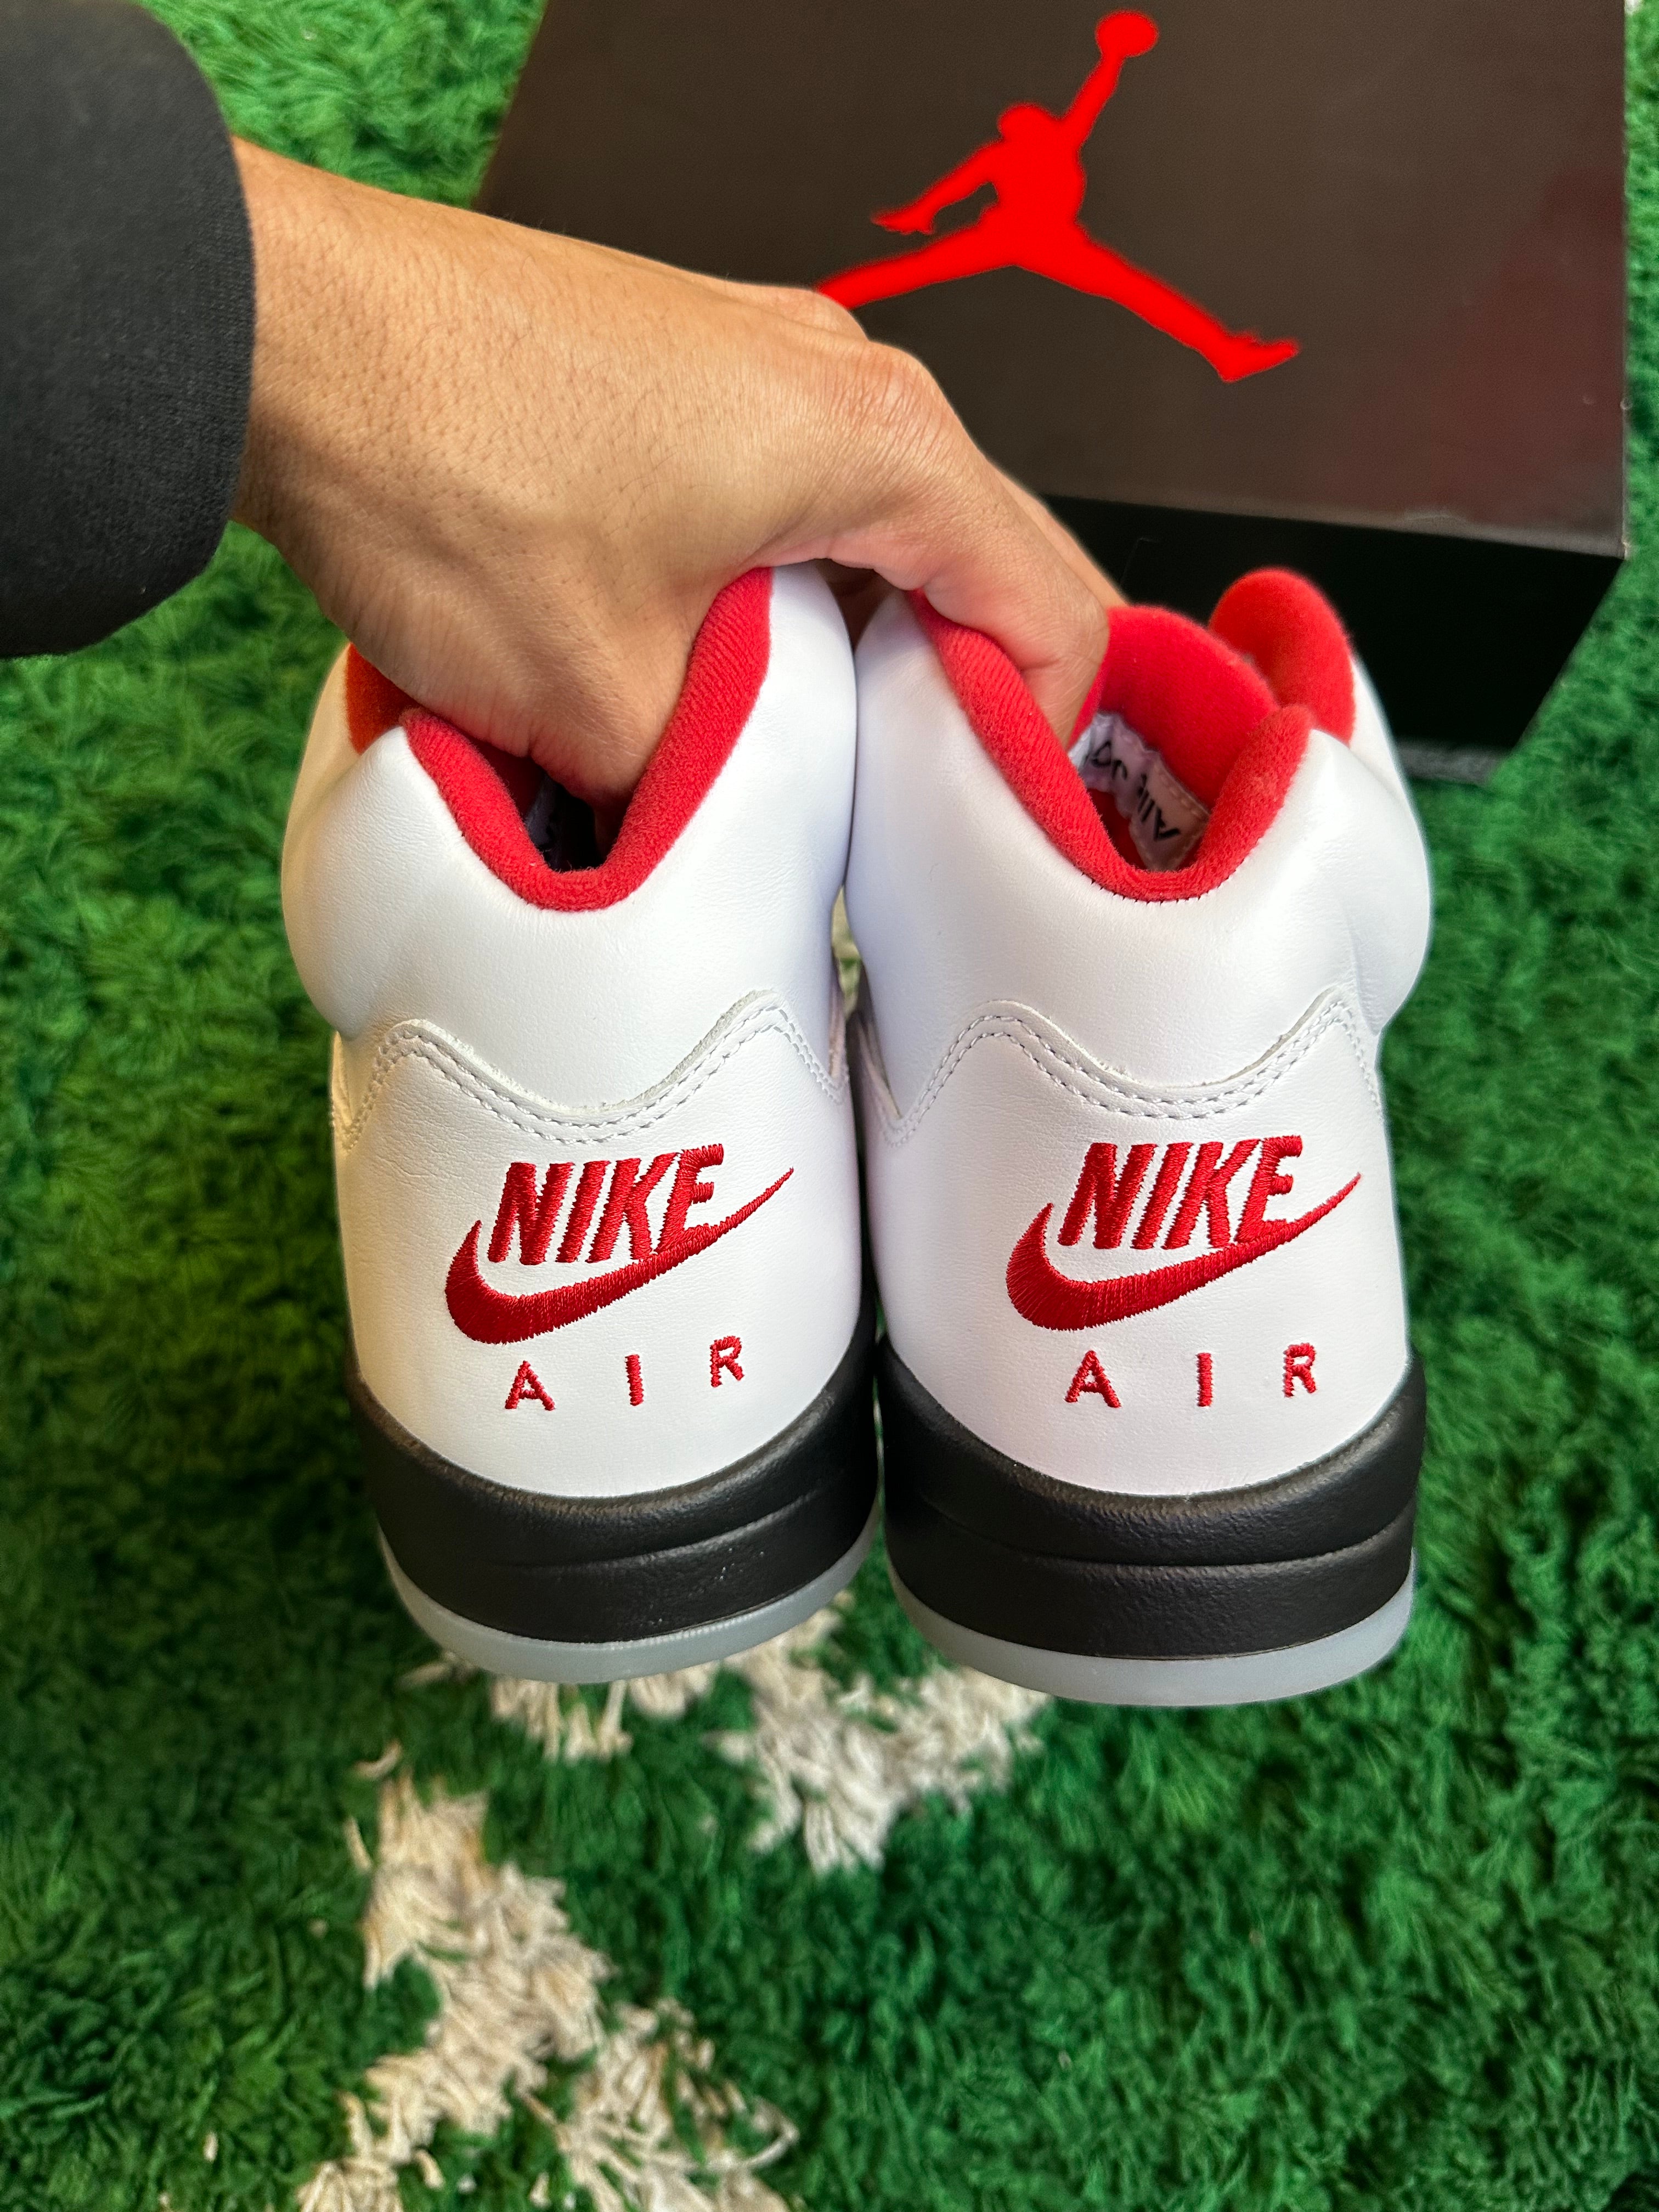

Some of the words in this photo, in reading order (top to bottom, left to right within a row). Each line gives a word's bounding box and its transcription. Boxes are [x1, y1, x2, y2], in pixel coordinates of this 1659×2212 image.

[487, 1143, 724, 1265] NIKE
[1057, 1135, 1303, 1250] NIKE
[504, 1335, 744, 1411] AIR
[1064, 1342, 1317, 1408] AIR
